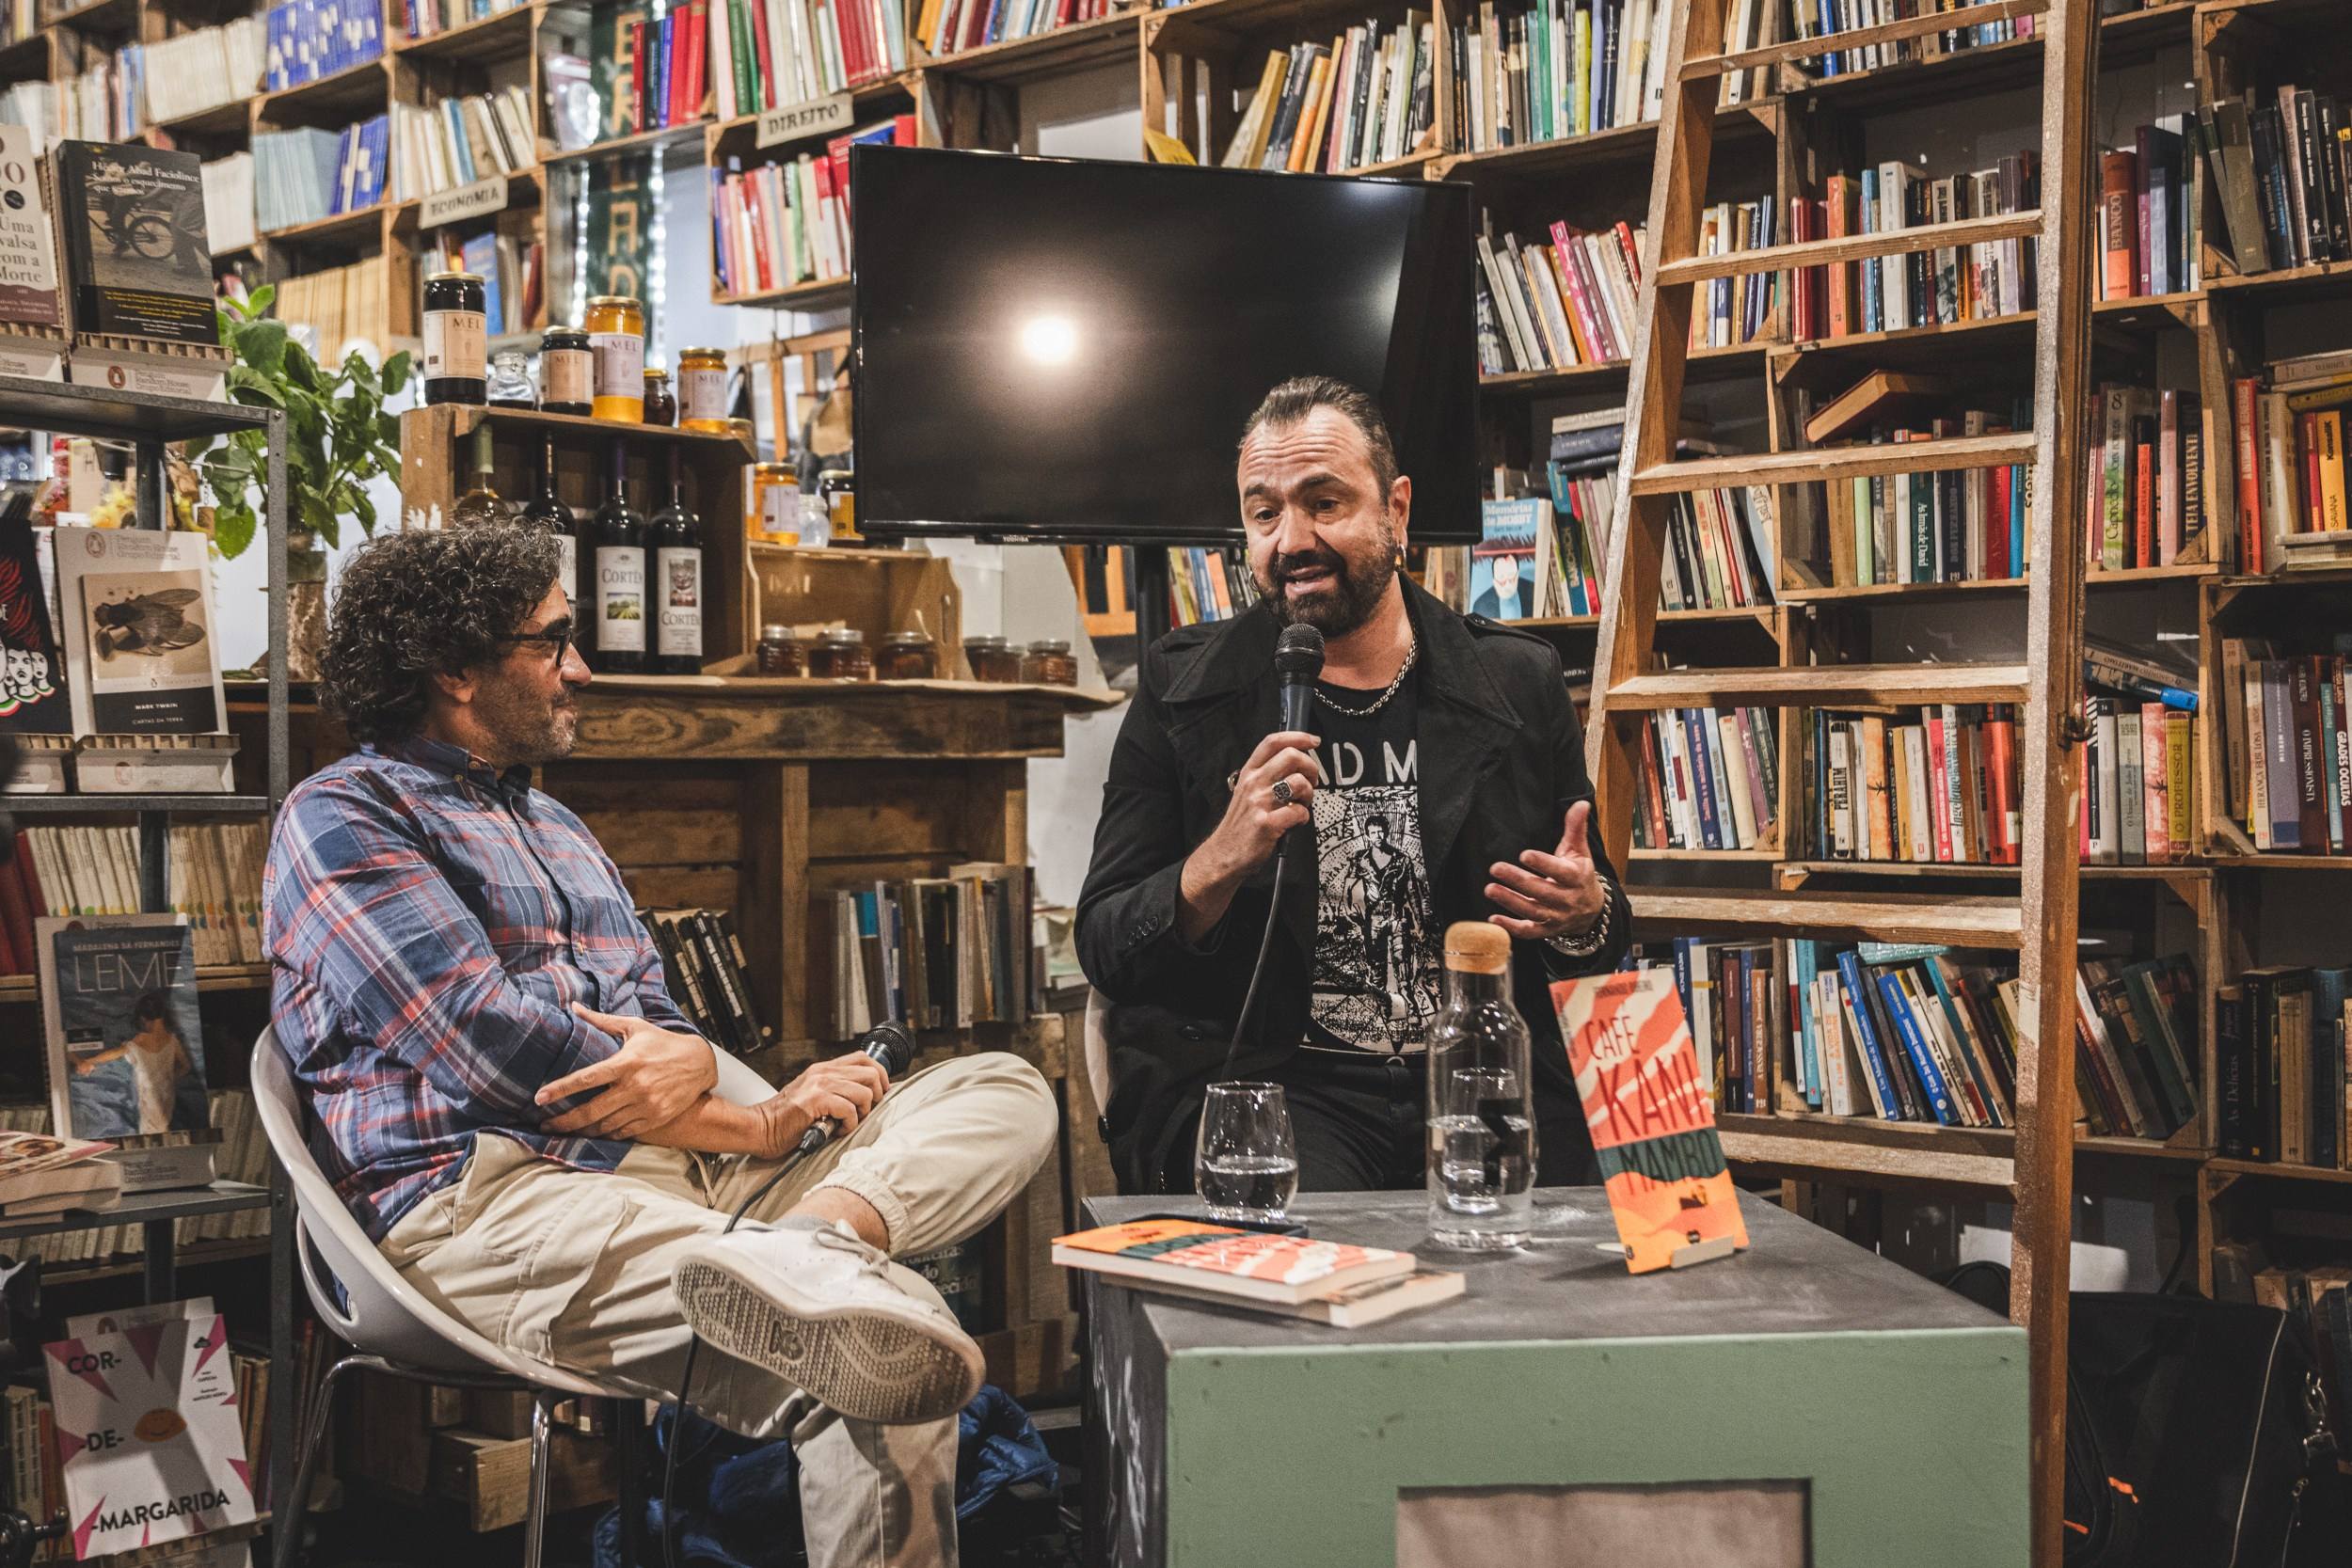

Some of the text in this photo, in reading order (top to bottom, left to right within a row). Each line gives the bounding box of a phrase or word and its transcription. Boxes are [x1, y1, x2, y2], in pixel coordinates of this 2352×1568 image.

[767, 103, 841, 136] DIREITO
[128, 165, 152, 176] Abad
[154, 166, 200, 182] Faciolince
[92, 185, 110, 194] que
[132, 178, 186, 191] esquecimento
[429, 186, 501, 217] ECONOMIA
[0, 216, 35, 234] Uma
[2109, 194, 2122, 251] BANCO
[32, 256, 40, 266] a
[453, 316, 483, 331] MEL
[611, 340, 639, 352] MEL
[555, 356, 580, 365] MEL
[698, 373, 723, 384] MEL
[1485, 503, 1534, 515] Memórias
[2185, 505, 2199, 531] TEIA
[2329, 494, 2340, 528] SAVANA
[1485, 515, 1532, 526] de MOSBY
[1917, 545, 1929, 567] David
[133, 717, 155, 725] CARTAS
[1308, 740, 1364, 786] AD
[2302, 737, 2316, 802] IMPRESSIONISTA
[2336, 730, 2352, 807] GRADES OCULTAS
[2172, 743, 2185, 818] PROFESSOR
[74, 940, 180, 952] MADALENA SÁ FERNANDES
[75, 950, 184, 992] LEME
[1756, 1024, 1765, 1073] PASSAGEIRA
[1596, 1050, 1707, 1141] KANI
[2227, 1110, 2240, 1126] As
[1617, 1130, 1720, 1196] MAMBO
[921, 1264, 939, 1280] do
[68, 1351, 122, 1375] COR-
